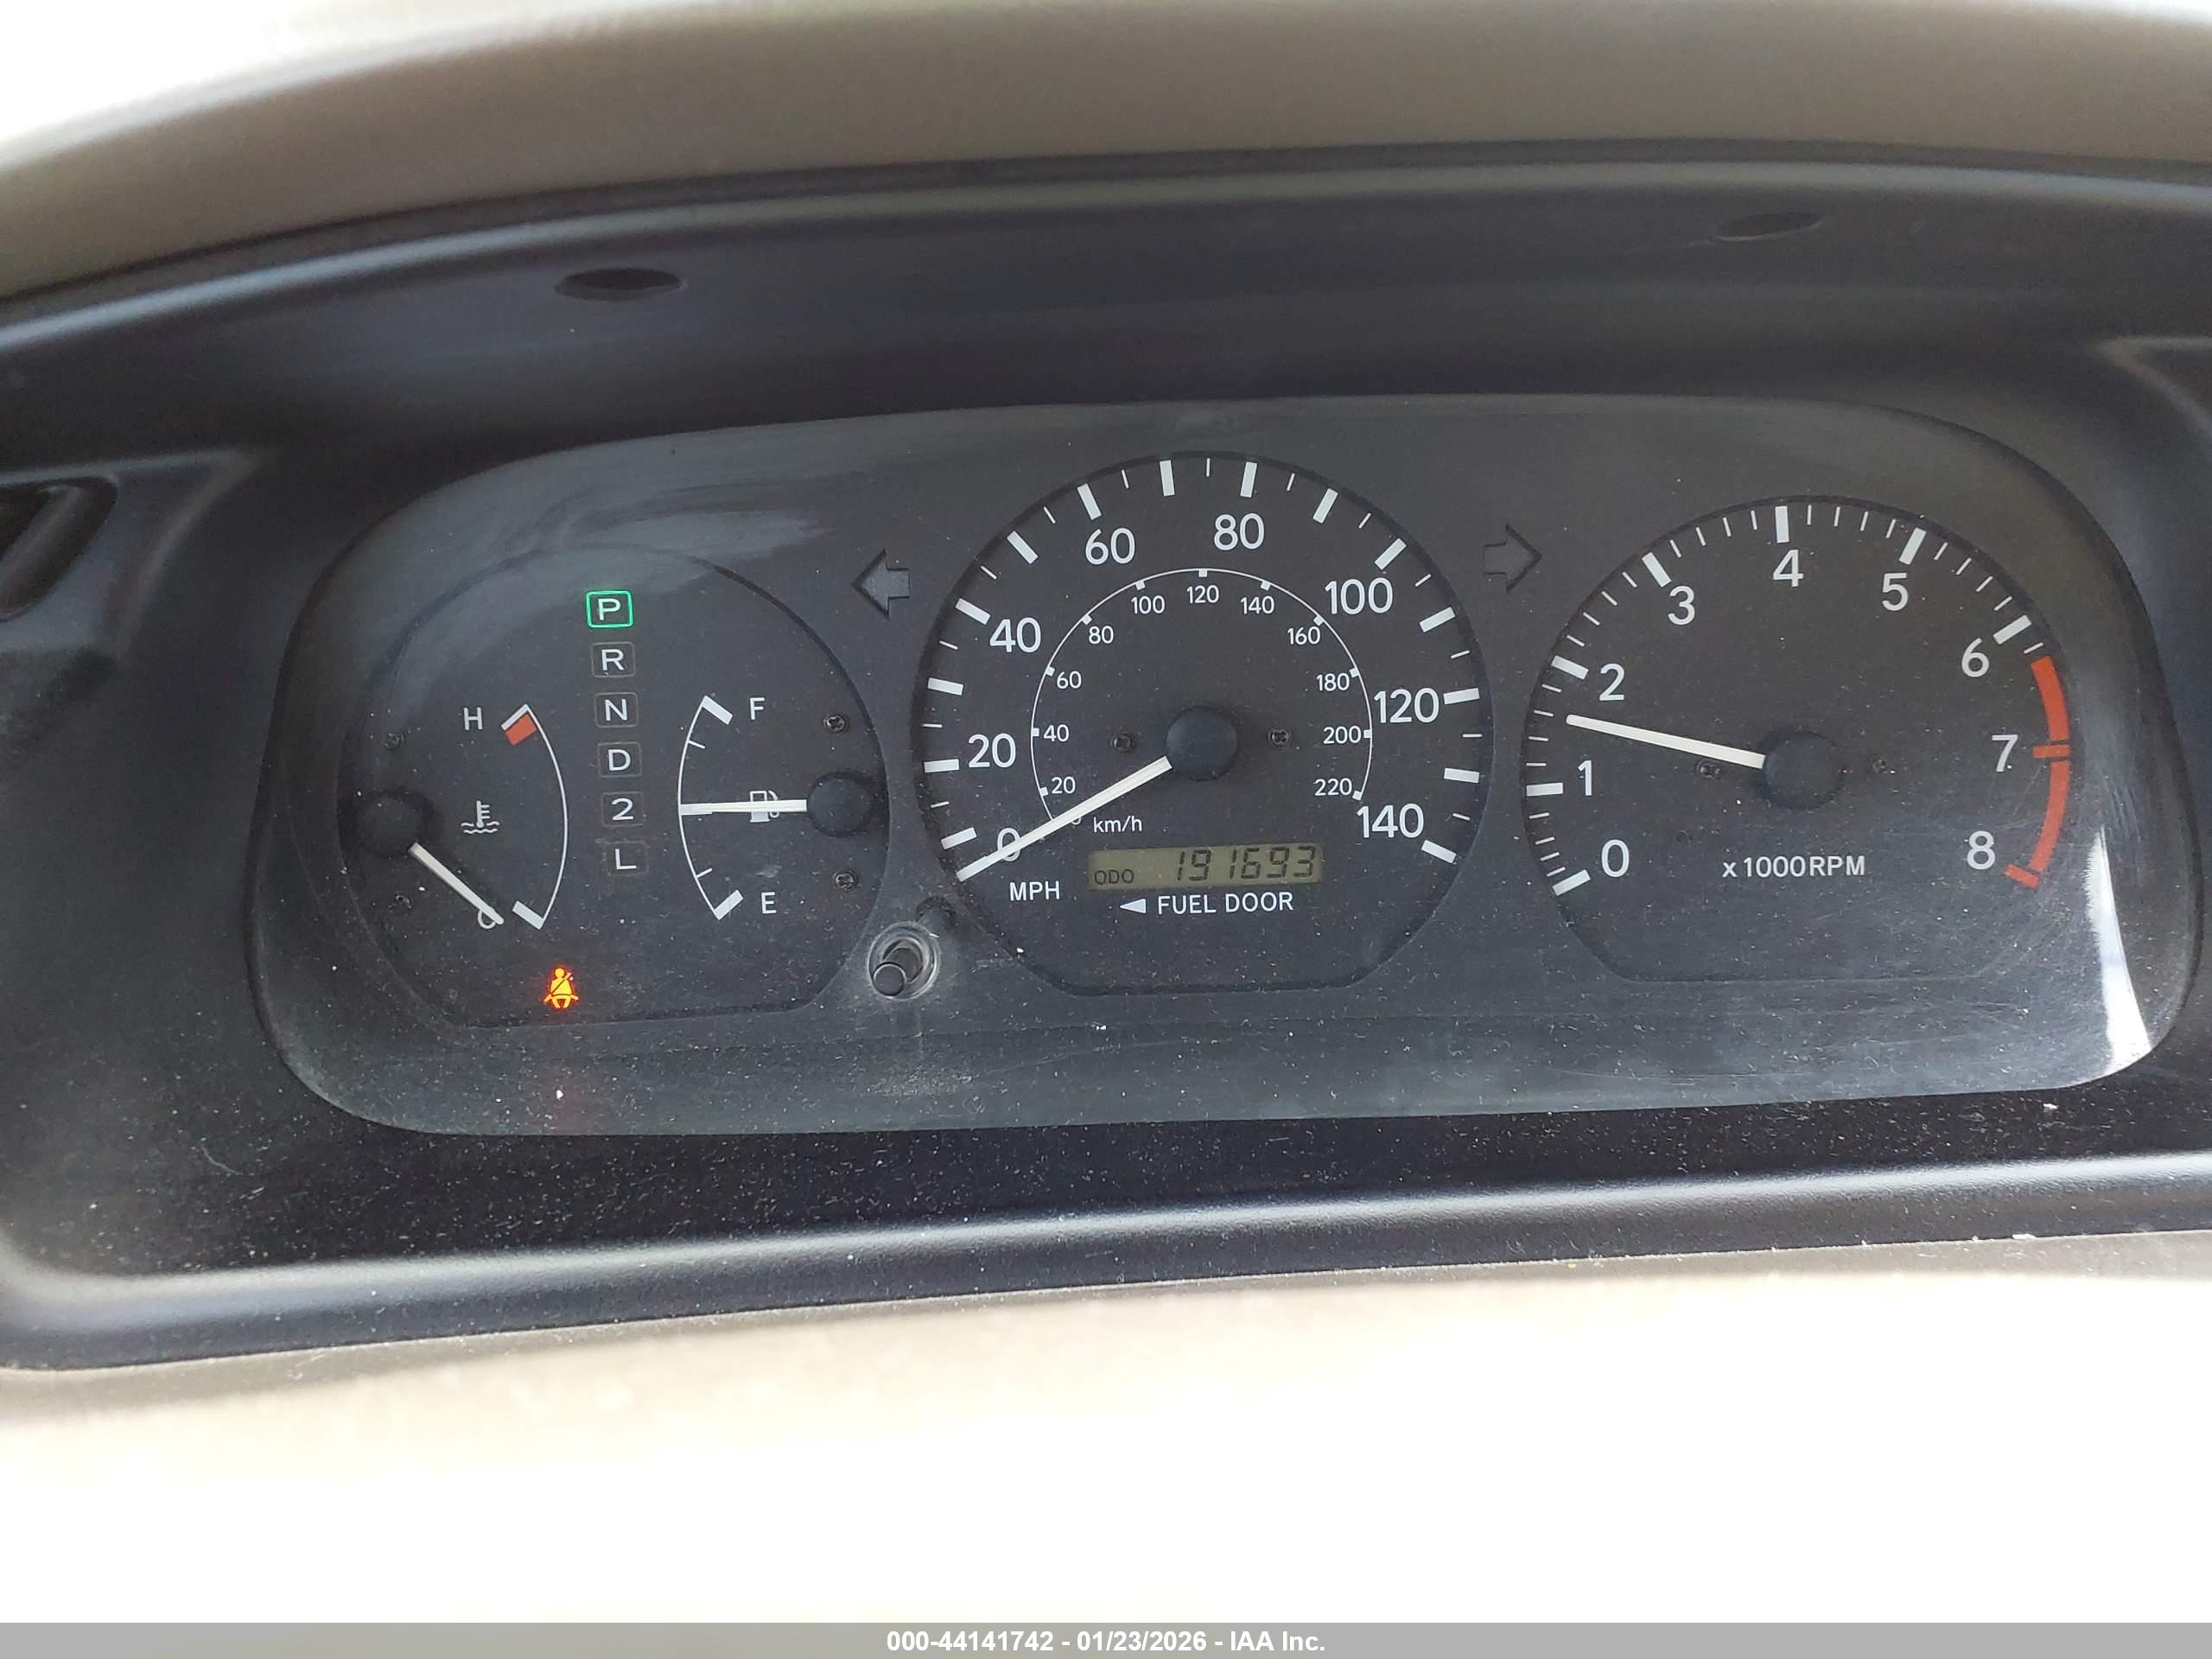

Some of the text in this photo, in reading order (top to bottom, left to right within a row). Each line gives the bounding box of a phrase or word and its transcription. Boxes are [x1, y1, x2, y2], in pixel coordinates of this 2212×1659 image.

[1213, 512, 1265, 550] 80
[1085, 527, 1135, 565] 60
[1772, 549, 1804, 588] 4
[1130, 594, 1166, 614] 100
[1186, 584, 1219, 604] 120
[1325, 577, 1393, 615] 100
[1882, 572, 1909, 612] 5
[598, 598, 621, 621] P
[1240, 595, 1274, 614] 140
[1668, 585, 1695, 626] 3
[988, 617, 1041, 653] 40
[1088, 625, 1114, 645] 80
[1287, 626, 1321, 645] 160
[601, 648, 625, 671] R
[1961, 638, 1990, 677] 6
[1056, 671, 1082, 690] 60
[1316, 672, 1350, 692] 180
[1599, 663, 1625, 702] 2
[604, 698, 627, 721] N
[749, 696, 766, 721] F
[1373, 689, 1440, 724] 120
[463, 707, 483, 731] H
[1043, 724, 1070, 743] 40
[1323, 725, 1361, 744] 200
[607, 748, 631, 772] D
[968, 733, 1016, 768] 20
[1992, 734, 2018, 772] 7
[1051, 776, 1076, 794] 20
[1313, 778, 1352, 797] 220
[1577, 760, 1592, 797] 1
[612, 798, 634, 821] 2
[1357, 803, 1424, 838] 140
[1093, 815, 1142, 833] km/h
[614, 849, 637, 870] L
[1601, 839, 1630, 878] 0
[1967, 830, 1996, 870] 8
[1177, 846, 1316, 881] 191693
[1094, 868, 1135, 886] ODO
[1009, 880, 1060, 901] MPH
[760, 892, 777, 914] E
[1158, 891, 1294, 915] FUEL DOOR
